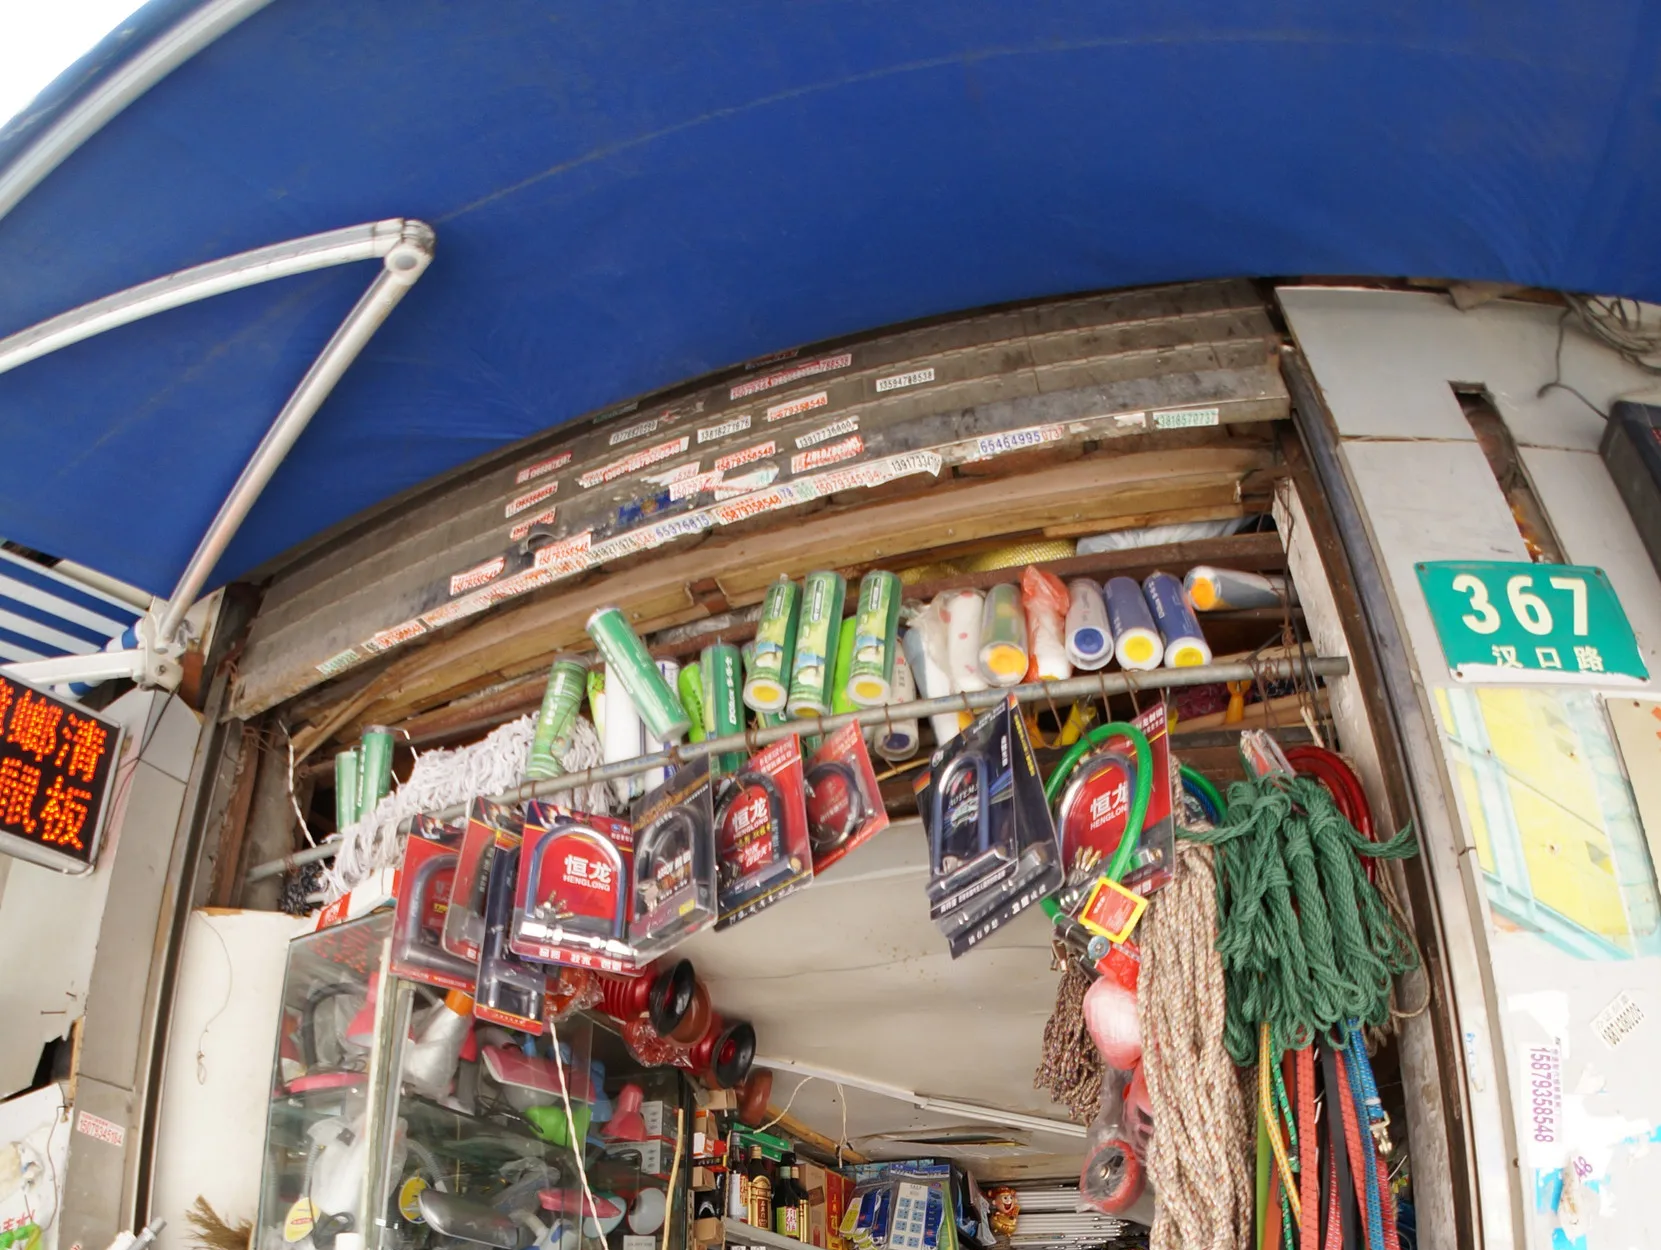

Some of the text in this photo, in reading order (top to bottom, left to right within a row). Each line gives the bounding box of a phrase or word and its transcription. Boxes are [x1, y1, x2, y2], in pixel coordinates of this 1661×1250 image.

[1452, 573, 1589, 637] 367
[1491, 644, 1605, 673] 汉口路
[562, 874, 611, 892] HENGLONG
[564, 854, 612, 883] 恒龙
[1529, 1046, 1555, 1143] 15879358548
